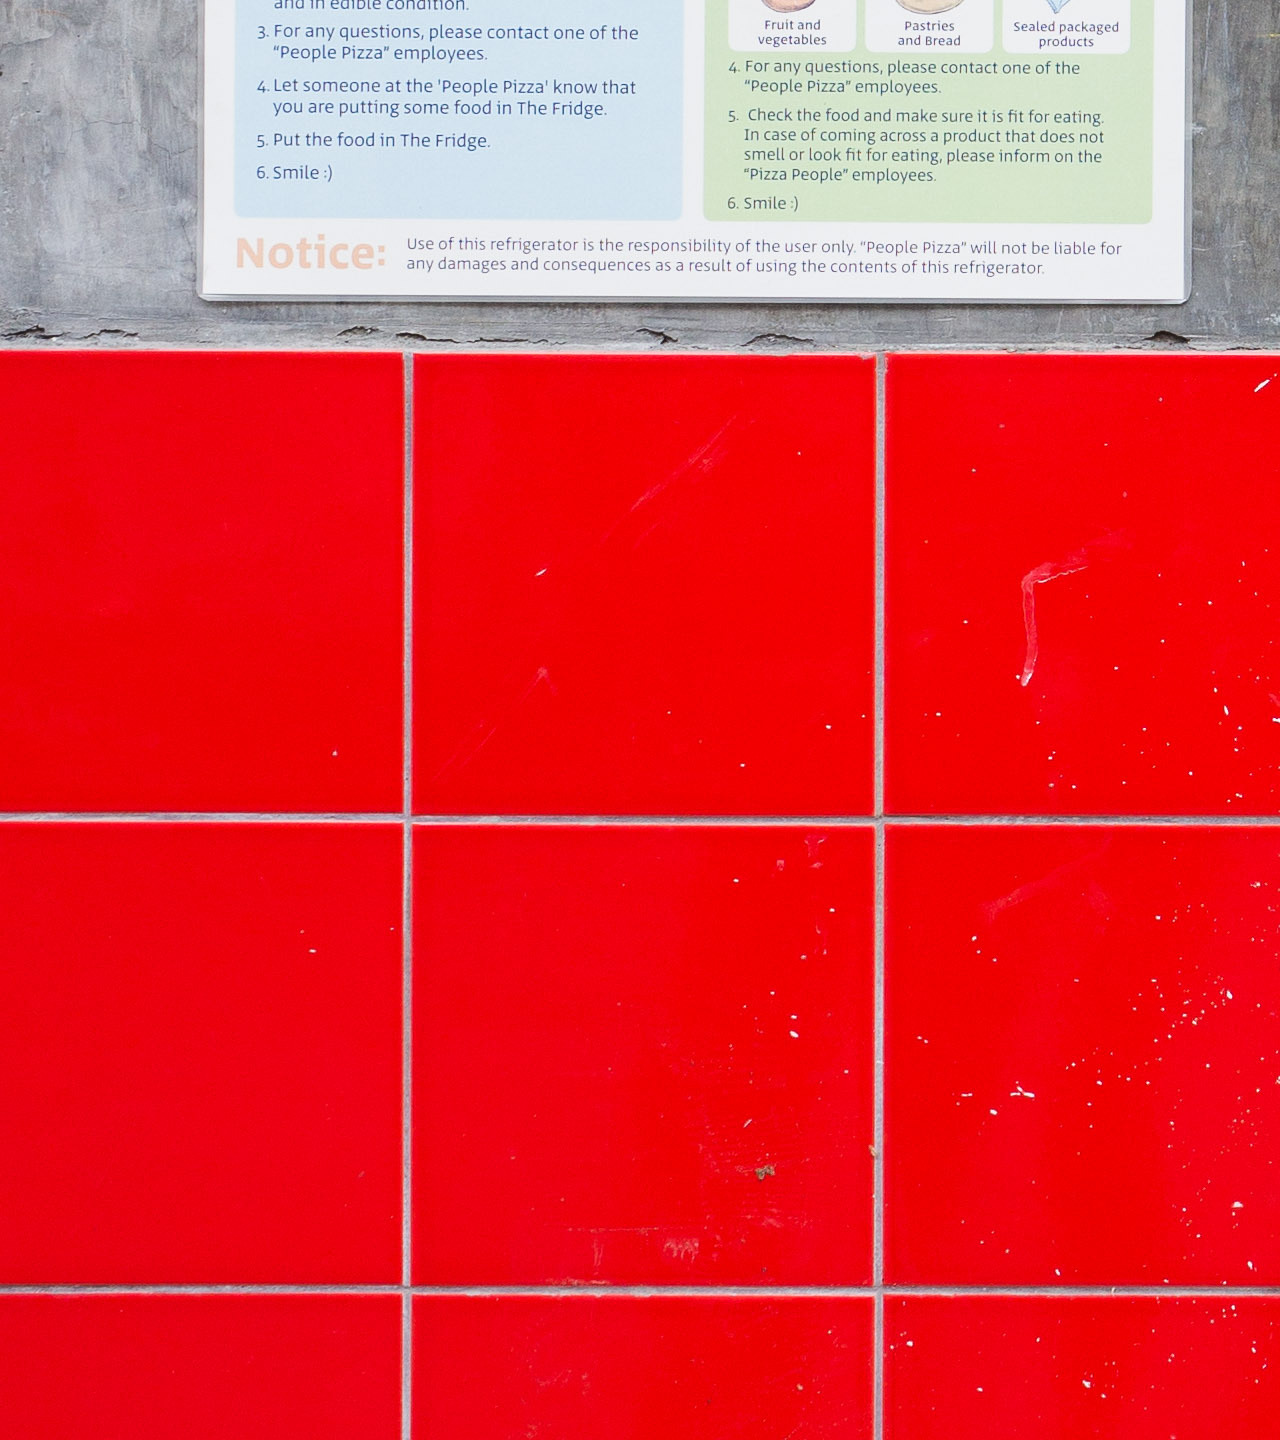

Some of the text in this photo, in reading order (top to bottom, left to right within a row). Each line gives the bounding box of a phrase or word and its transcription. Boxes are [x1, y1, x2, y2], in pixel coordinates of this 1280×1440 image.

[748, 107, 793, 121] Check
[797, 107, 821, 122] the
[825, 107, 859, 122] food
[864, 108, 891, 122] and
[896, 108, 938, 123] make
[941, 112, 973, 123] sure
[977, 109, 987, 123] it
[992, 109, 1004, 123] is
[1008, 109, 1024, 123] fit
[1028, 109, 1050, 123] for
[1054, 110, 1104, 127] eating.
[274, 133, 300, 146] Put
[305, 131, 332, 147] the
[337, 131, 375, 147] food
[380, 133, 395, 147] in
[400, 132, 431, 148] The
[436, 133, 490, 152] Fridge.
[273, 165, 320, 180] Smile
[236, 233, 385, 269] Notice:
[407, 238, 434, 250] Use
[438, 236, 455, 250] of
[458, 237, 486, 251] this
[490, 236, 579, 255] refrigerator
[583, 238, 594, 251] is
[599, 238, 624, 252] the
[628, 238, 731, 255] responsibility
[735, 238, 752, 253] of
[755, 239, 780, 253] the
[785, 242, 817, 253] user
[821, 240, 858, 256] only.
[970, 240, 997, 254] will
[1002, 242, 1027, 255] not
[1031, 241, 1050, 255] be
[1054, 241, 1096, 255] liable
[1100, 241, 1122, 255] for
